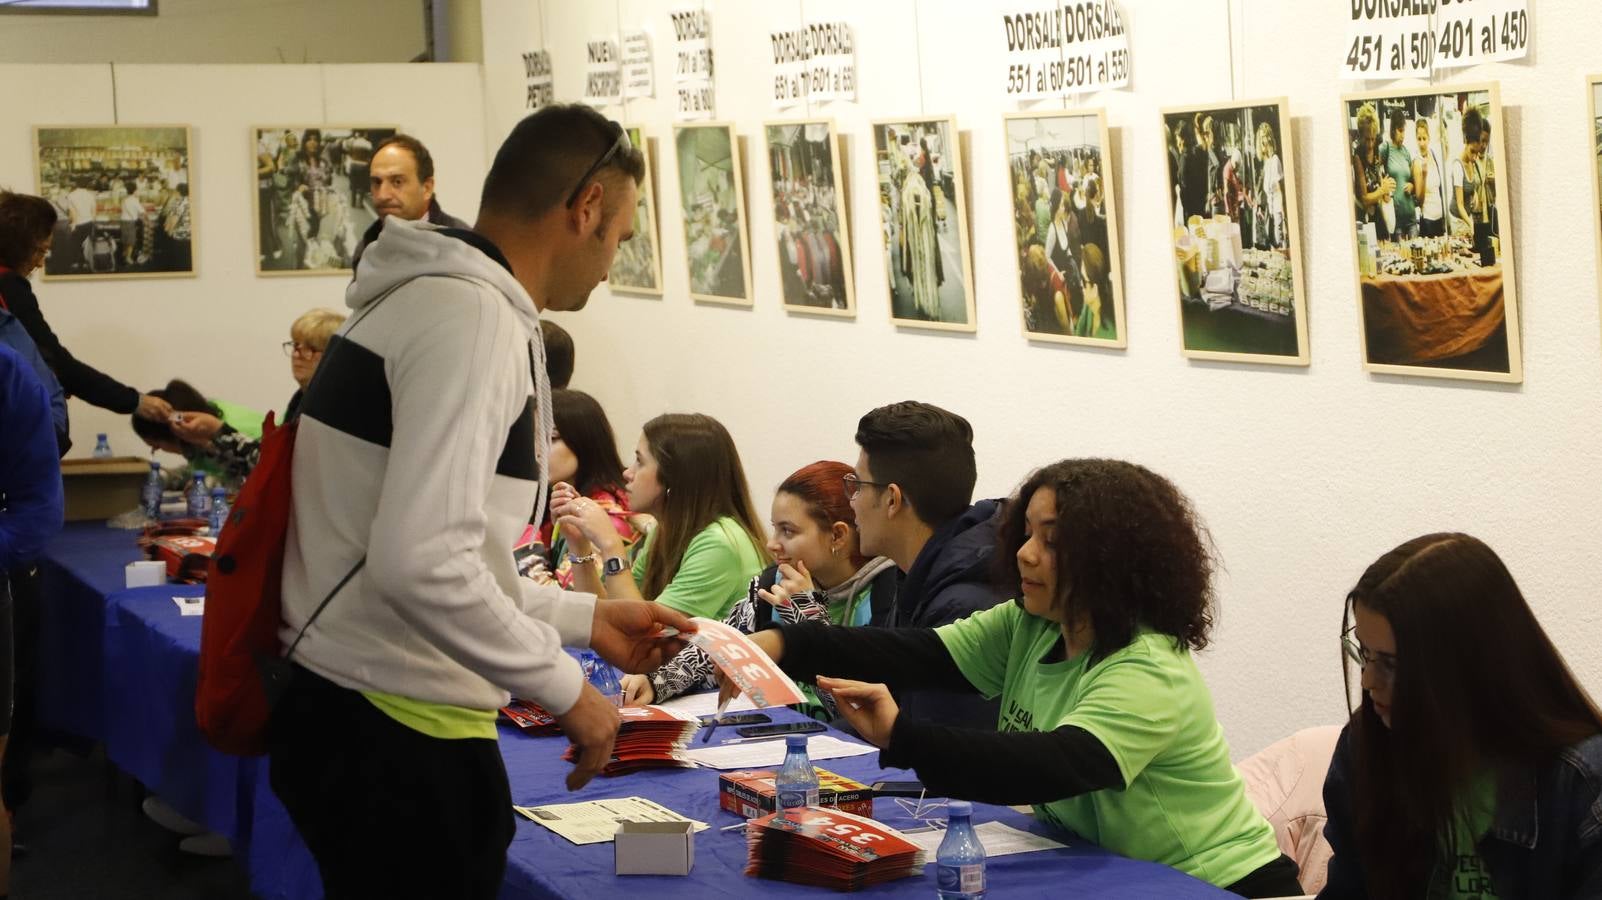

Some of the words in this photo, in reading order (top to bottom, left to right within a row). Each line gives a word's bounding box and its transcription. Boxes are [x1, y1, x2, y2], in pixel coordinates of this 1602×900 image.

[1439, 18, 1474, 59] 401
[1481, 15, 1497, 55] al
[1501, 9, 1528, 51] 450
[1066, 54, 1092, 87] 501
[1098, 52, 1109, 83] al
[1112, 48, 1129, 82] 550
[1346, 34, 1383, 72] 451
[1390, 34, 1406, 71] al
[775, 75, 789, 100] 651
[812, 67, 830, 92] 601
[1007, 64, 1031, 94] 551
[1037, 63, 1047, 92] al
[838, 793, 860, 801] ACERO
